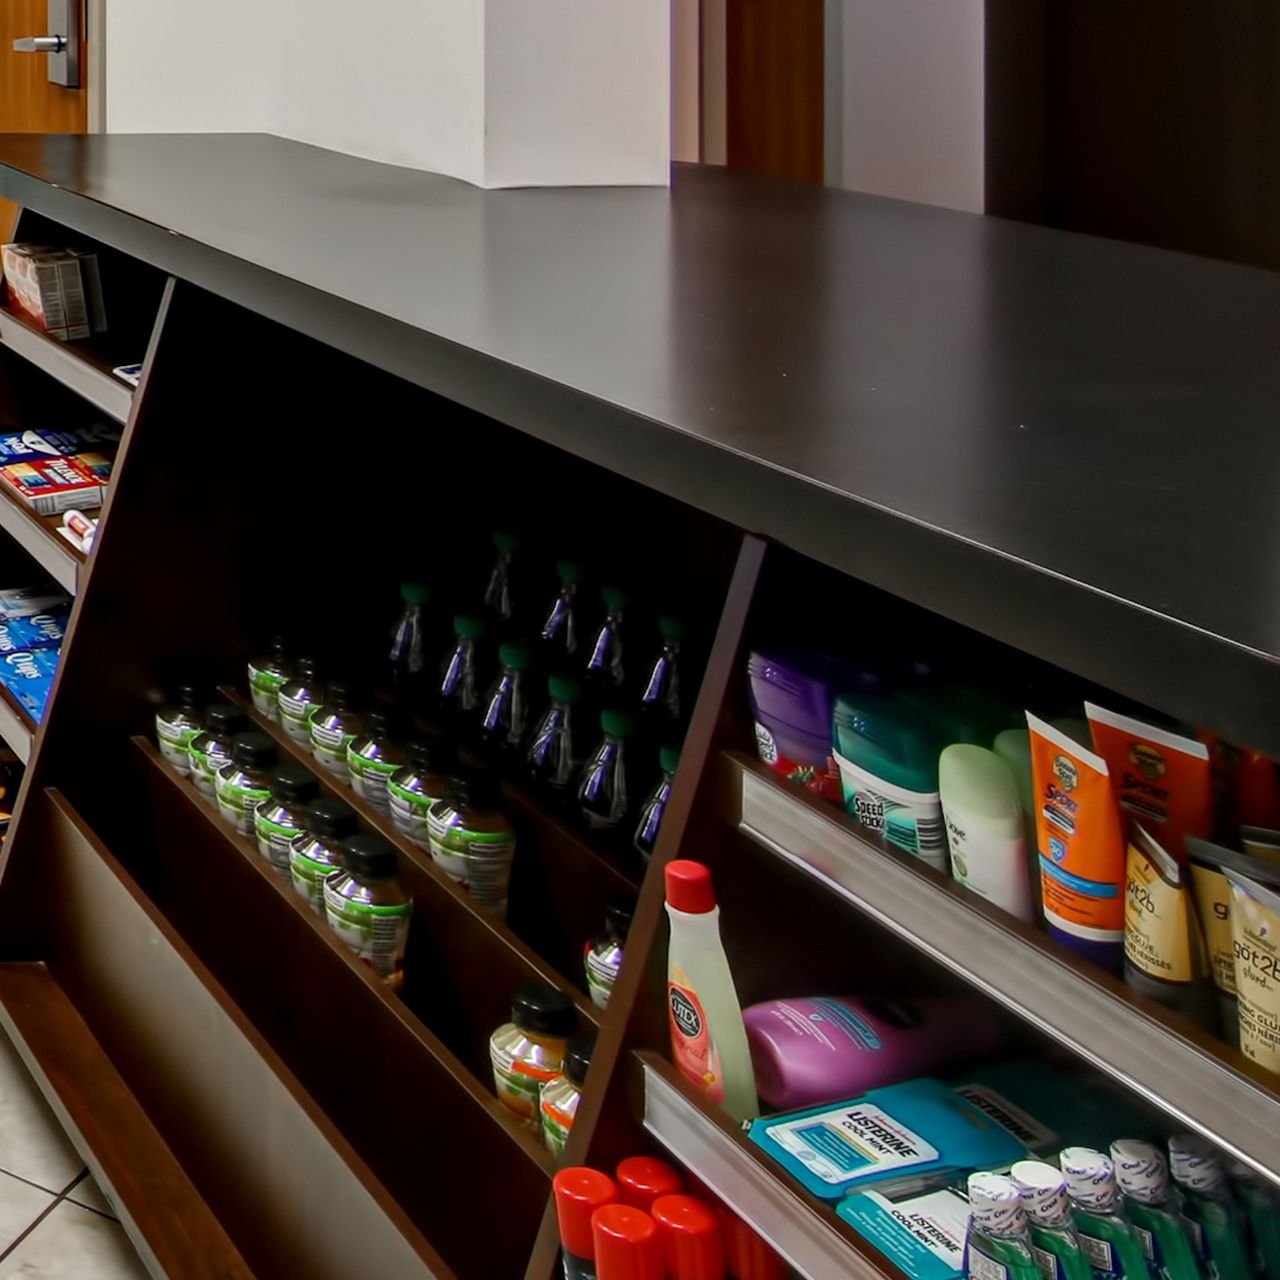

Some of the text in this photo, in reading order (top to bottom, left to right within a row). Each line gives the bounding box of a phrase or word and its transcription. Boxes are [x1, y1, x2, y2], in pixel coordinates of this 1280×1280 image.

[841, 1120, 868, 1140] COOL
[866, 1136, 895, 1157] MINT
[846, 1111, 920, 1159] LISTERINE
[891, 1209, 940, 1249] COOL MINT
[909, 1212, 962, 1254] LISTERINE
